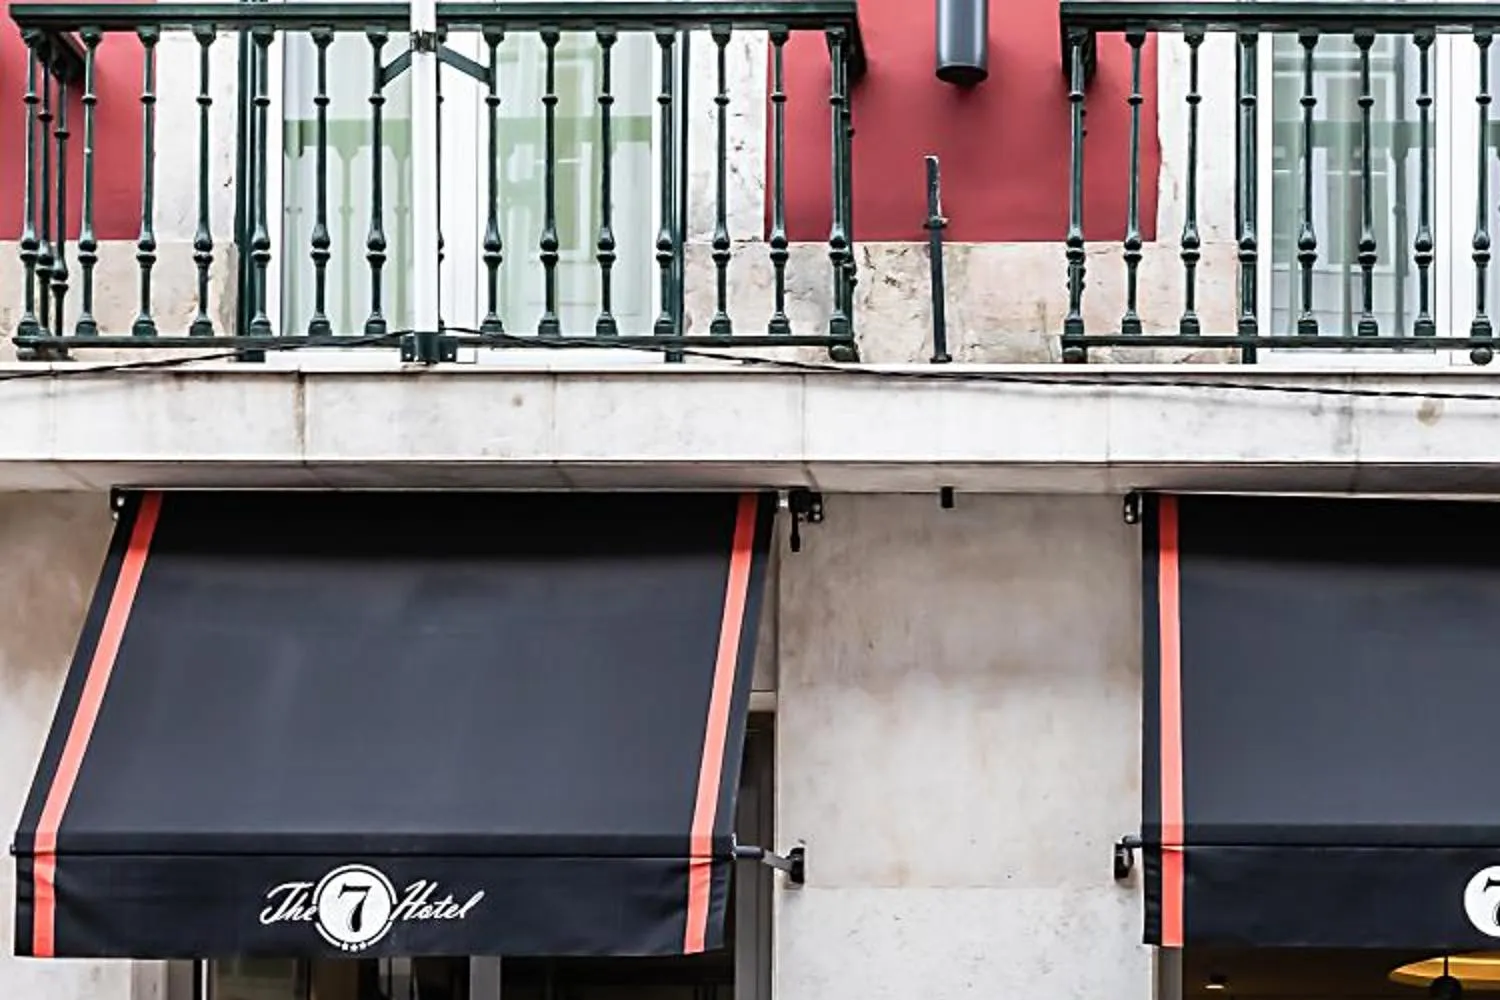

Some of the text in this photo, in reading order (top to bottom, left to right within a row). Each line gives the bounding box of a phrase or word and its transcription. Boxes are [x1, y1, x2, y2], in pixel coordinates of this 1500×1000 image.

[259, 879, 485, 933] The 7 Hotel
